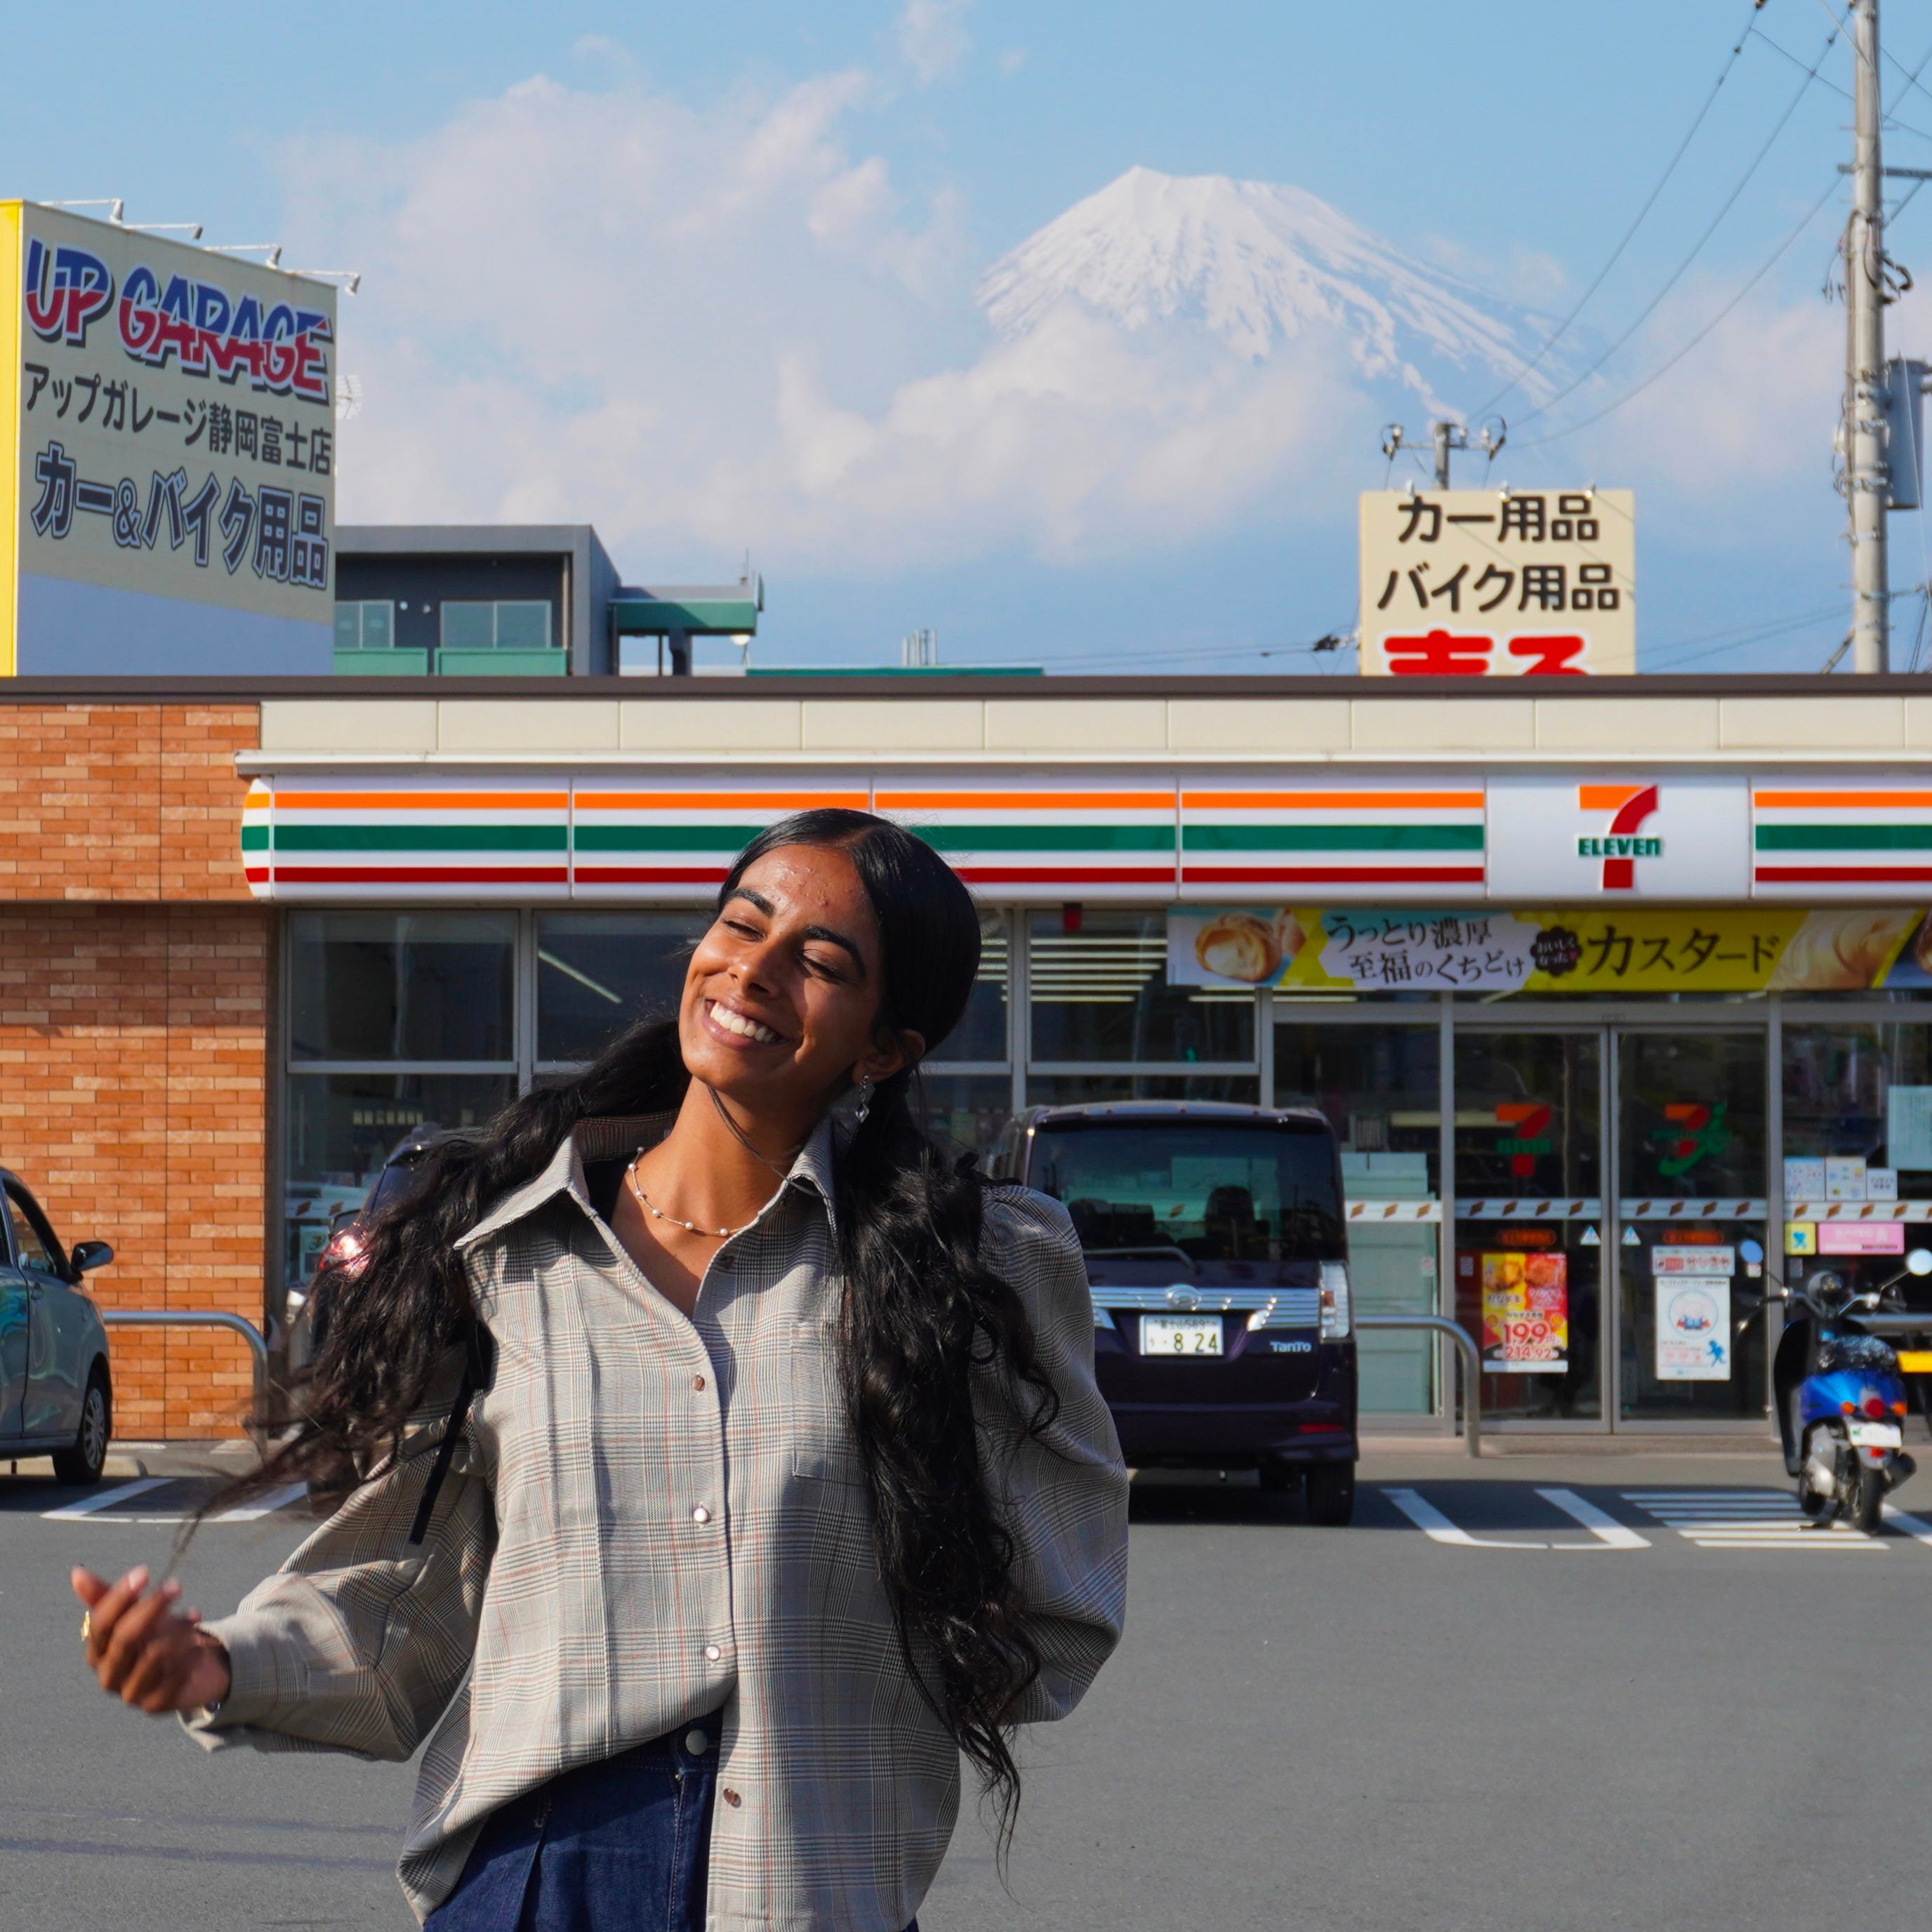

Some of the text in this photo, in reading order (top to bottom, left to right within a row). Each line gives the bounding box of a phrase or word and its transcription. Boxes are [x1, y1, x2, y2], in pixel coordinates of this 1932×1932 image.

[25, 237, 334, 406] UP GARAGE
[25, 362, 332, 475] アップガレージ静岡富士店
[31, 440, 329, 589] カー&バイク用品
[1398, 495, 1599, 543] カー用品
[1377, 562, 1620, 612] バイク用品
[1579, 784, 1658, 891] 7
[1328, 916, 1493, 952] うっとり濃厚
[1587, 925, 1780, 977] カスタード
[1349, 949, 1525, 984] 至福のくちどけ
